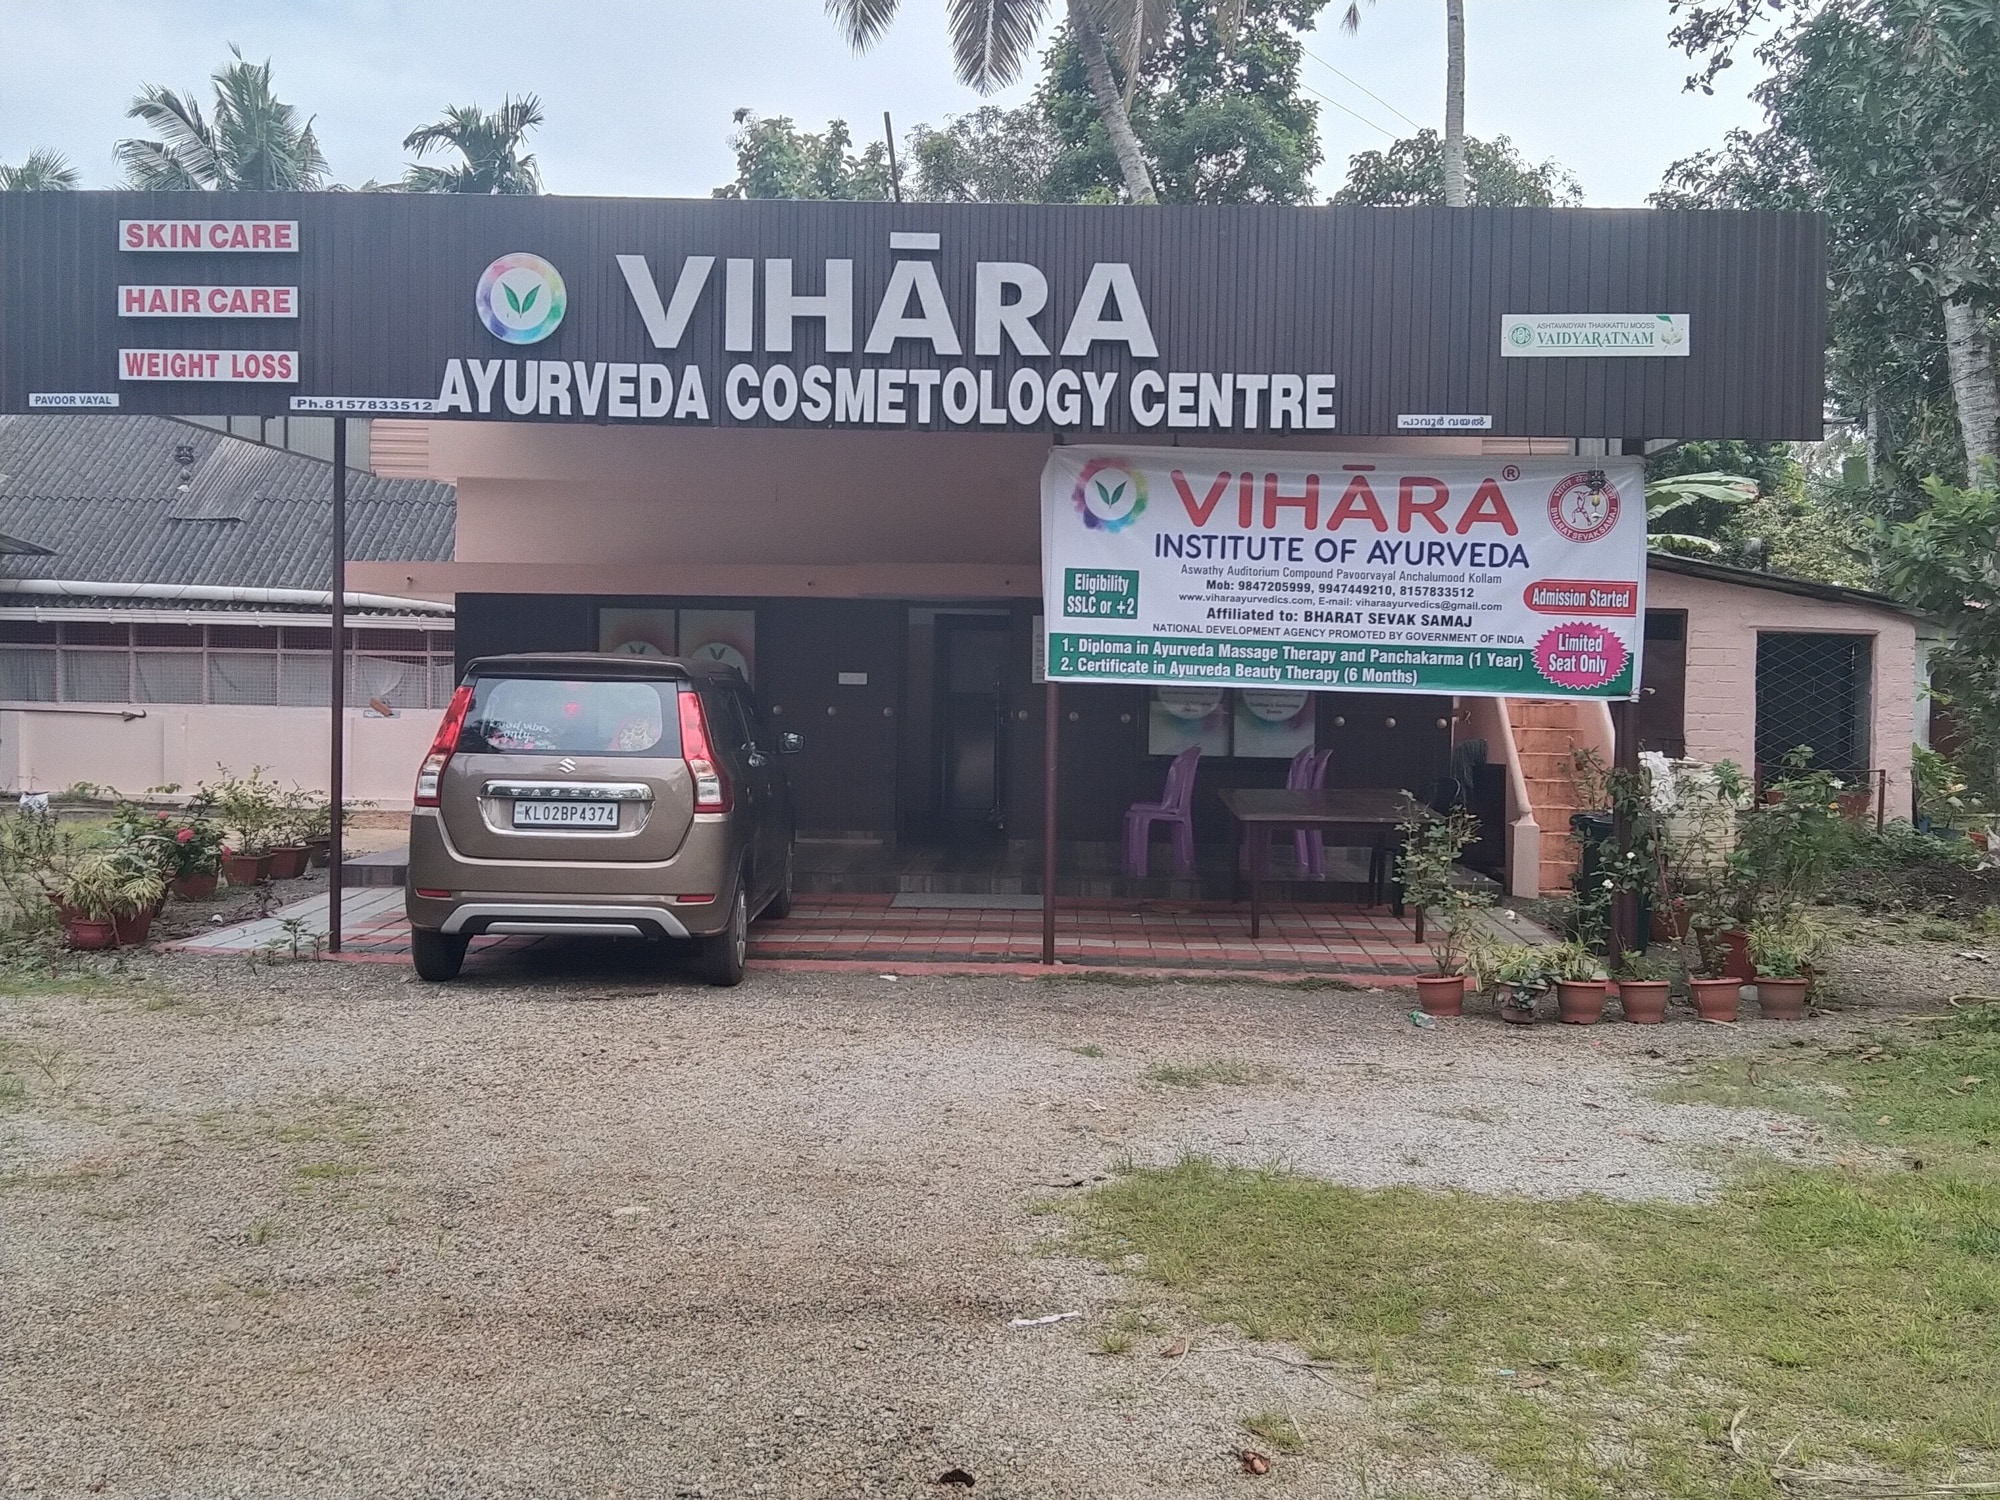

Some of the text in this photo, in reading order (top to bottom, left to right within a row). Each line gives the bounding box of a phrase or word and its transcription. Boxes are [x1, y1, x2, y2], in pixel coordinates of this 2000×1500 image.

[126, 223, 292, 249] SKIN CARE
[125, 288, 291, 314] HAIR CARE
[616, 231, 1159, 358] VIHĀRA
[1536, 321, 1587, 330] ASHTAVAIDYAN
[1537, 331, 1655, 348] VAIDYARATNAM
[125, 352, 292, 379] WEIGHT LOSS
[35, 395, 112, 405] PAVOOR VAYAL
[439, 358, 1336, 429] AYURVEDA COSMETOLOGY CENTRE
[296, 399, 433, 411] Ph.8157833512
[1170, 464, 1519, 537] VIHĀRA
[1551, 506, 1618, 540] BHARAT SEVAK SAMAJ
[1155, 533, 1530, 569] INSTITUTE OF AYURVEDA
[1074, 573, 1130, 595] Eligibility
[1181, 564, 1502, 584] Aswathy Auditorium Compound Pavoorvayal Anchalumood Kollam
[1206, 579, 1475, 598] Mob: 9847205999, 9947449210, 8157833512
[1532, 587, 1629, 608] Admission Started
[1067, 596, 1135, 615] SSLC or +2
[1179, 592, 1503, 612] www.viharaayurvedics.com, E-mail: viharaayurvedics@gmail.com
[1206, 607, 1473, 628] Affiliated to: BHARAT SEVAK SAMAJ
[1152, 623, 1525, 644] NATIONAL DEVELOPMENT AGENCY PROMOTED BY GOVERNMENT OF INDIA
[1558, 633, 1603, 652] Limited
[1062, 638, 1524, 670] 1. Diploma in Ayurveda Massage Therapy and Panchakarma (1 Year)
[1060, 657, 1418, 686] 2. Certificate in Ayurveda Beauty Therapy (6 Months)
[1548, 654, 1607, 677] Seat Only
[524, 805, 614, 822] KL02BP4374
